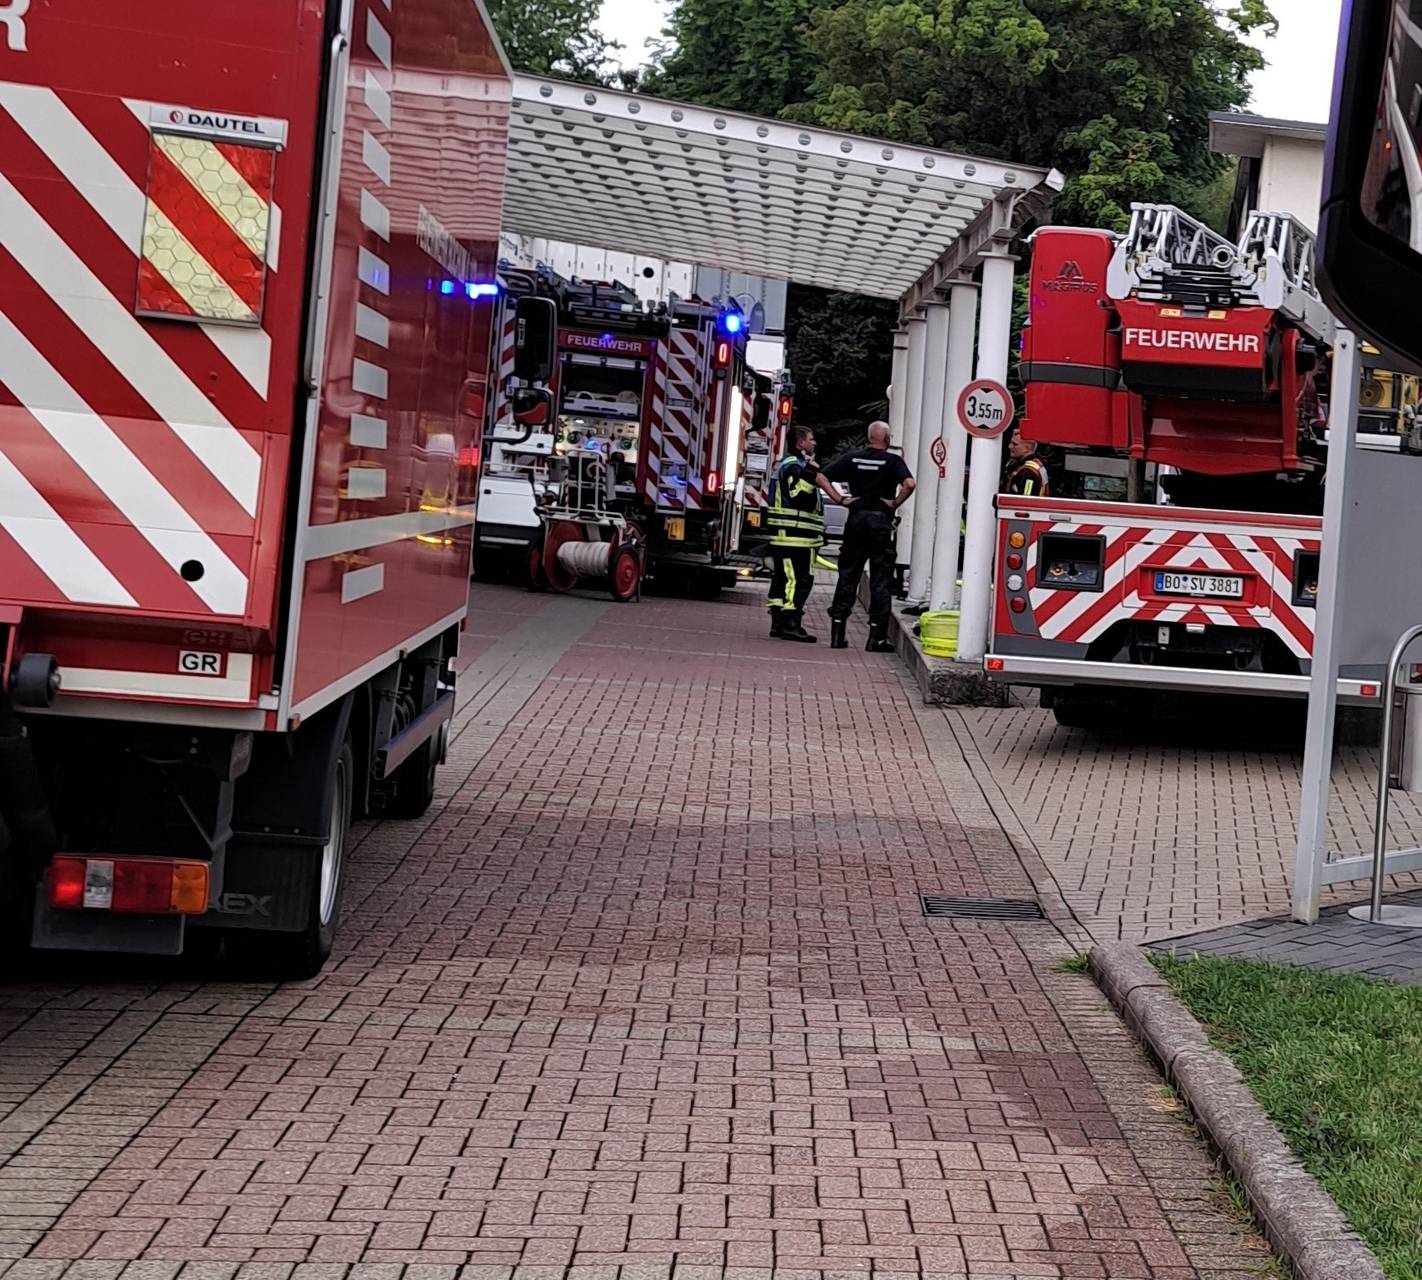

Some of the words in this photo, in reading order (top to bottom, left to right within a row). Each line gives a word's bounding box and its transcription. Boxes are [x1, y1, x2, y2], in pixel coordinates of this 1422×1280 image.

[187, 113, 265, 134] DAUTEL
[567, 334, 642, 352] FEUERWEHR
[1125, 327, 1260, 353] FEUERWEHR
[1208, 578, 1240, 593] 3881
[182, 653, 217, 672] GR
